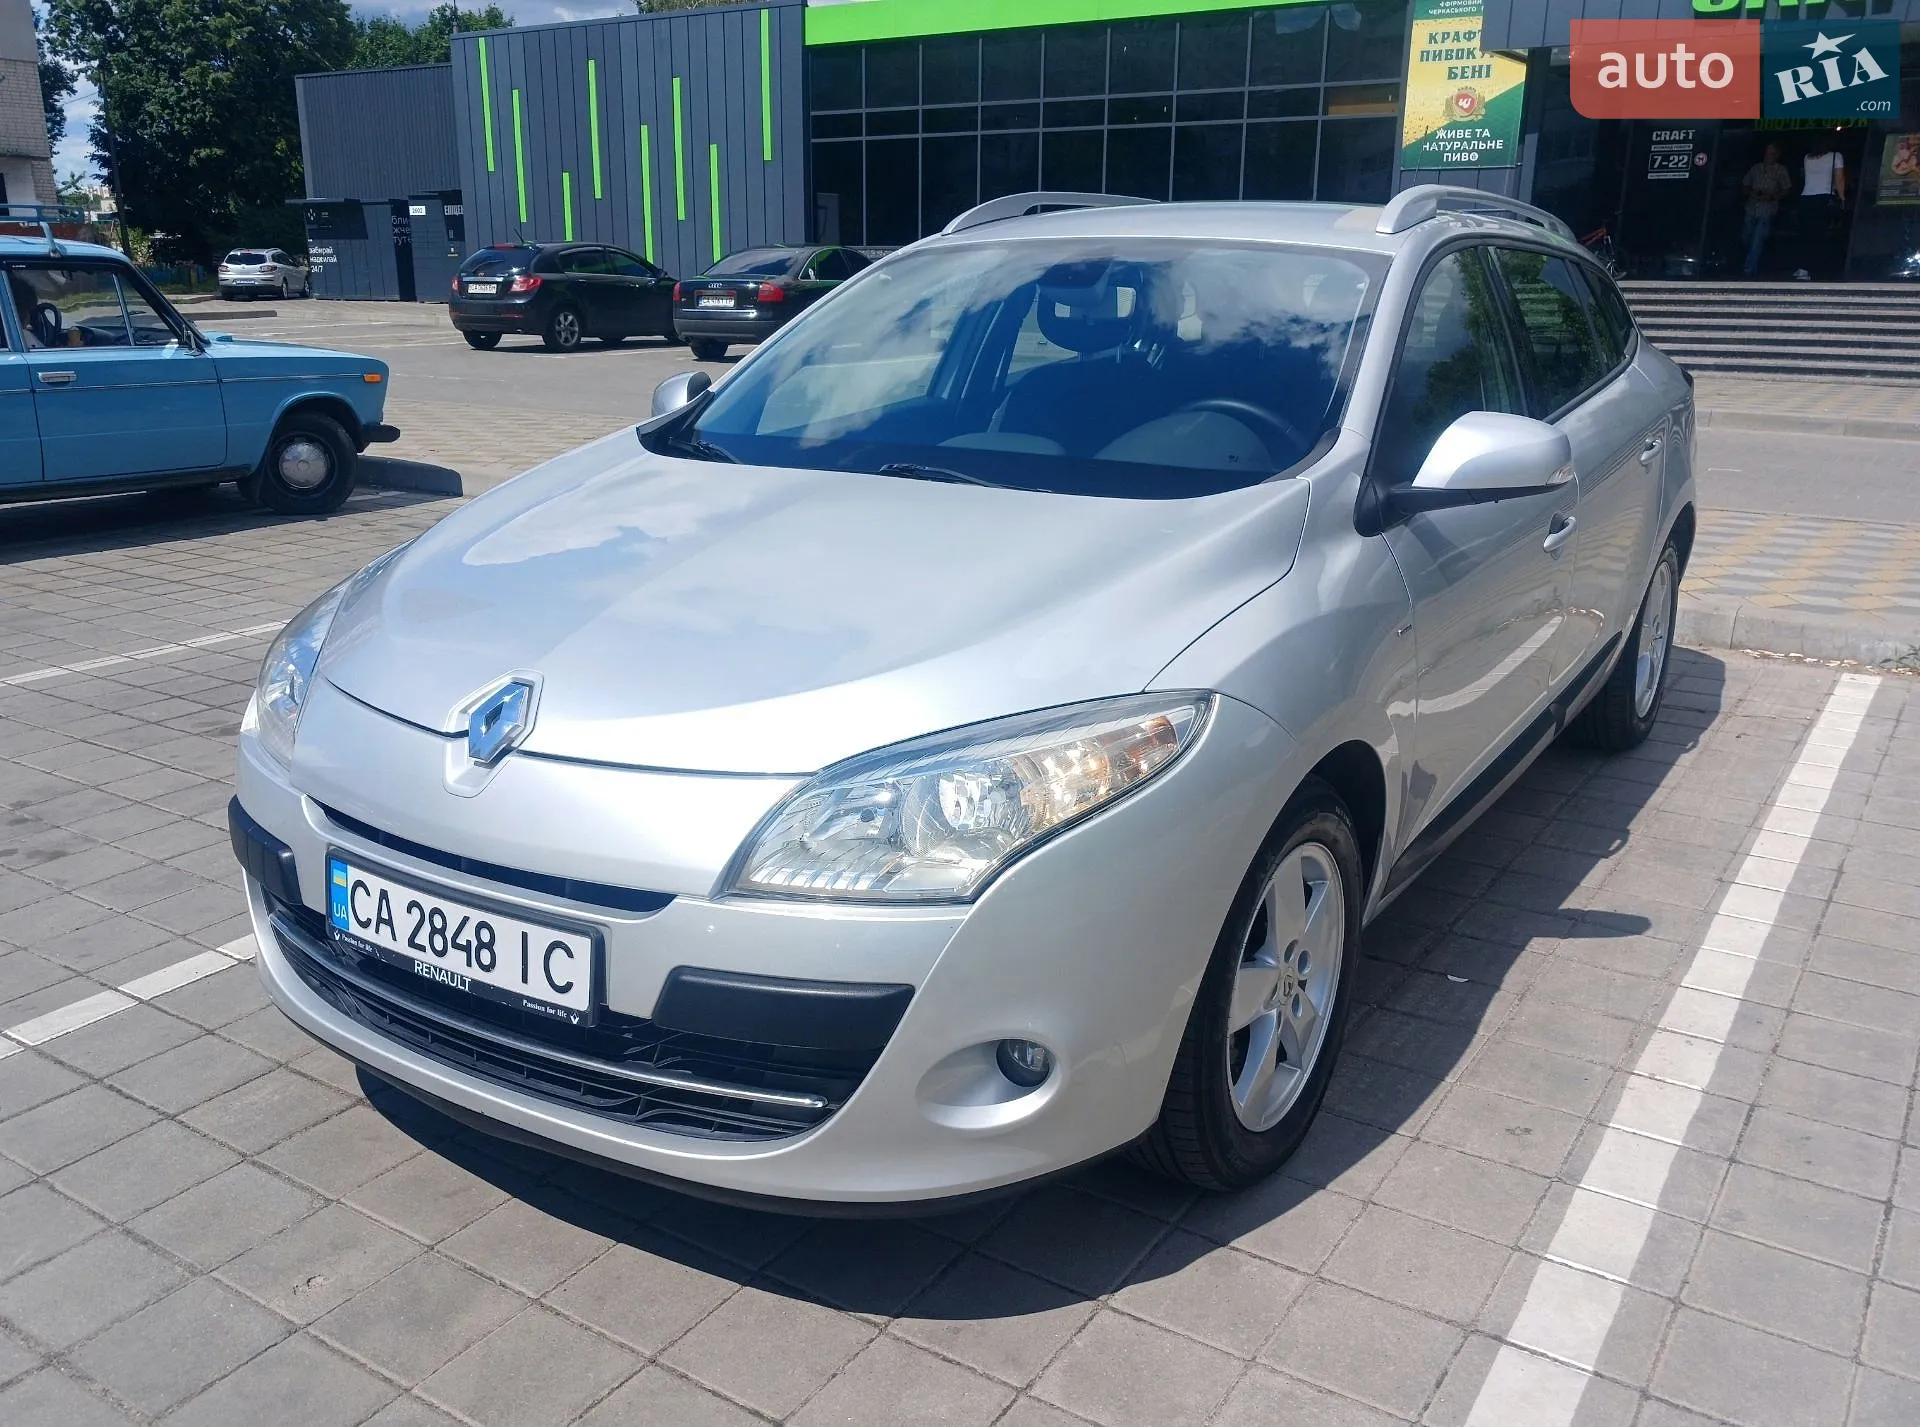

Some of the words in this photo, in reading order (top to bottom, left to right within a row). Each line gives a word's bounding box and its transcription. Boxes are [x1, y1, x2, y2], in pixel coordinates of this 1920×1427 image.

[1428, 6, 1477, 15] ЧЕРКАСЬКОГО
[1447, 64, 1492, 80] БЕНІ
[1435, 128, 1472, 140] ЖИВЕ
[1475, 128, 1491, 138] ТА
[1652, 129, 1696, 141] CRAFT
[1422, 140, 1504, 152] НАТУРАЛЬНЕ
[1443, 152, 1479, 162] ПИВО
[1653, 155, 1689, 168] 7-22
[311, 265, 324, 273] 24/7
[333, 901, 348, 921] UA
[350, 879, 397, 941] CA
[406, 900, 497, 972] 2848
[521, 930, 575, 994] IC
[414, 959, 472, 992] RENAULT
[522, 999, 546, 1011] Passion
[546, 1006, 557, 1015] for
[557, 1009, 568, 1018] life
